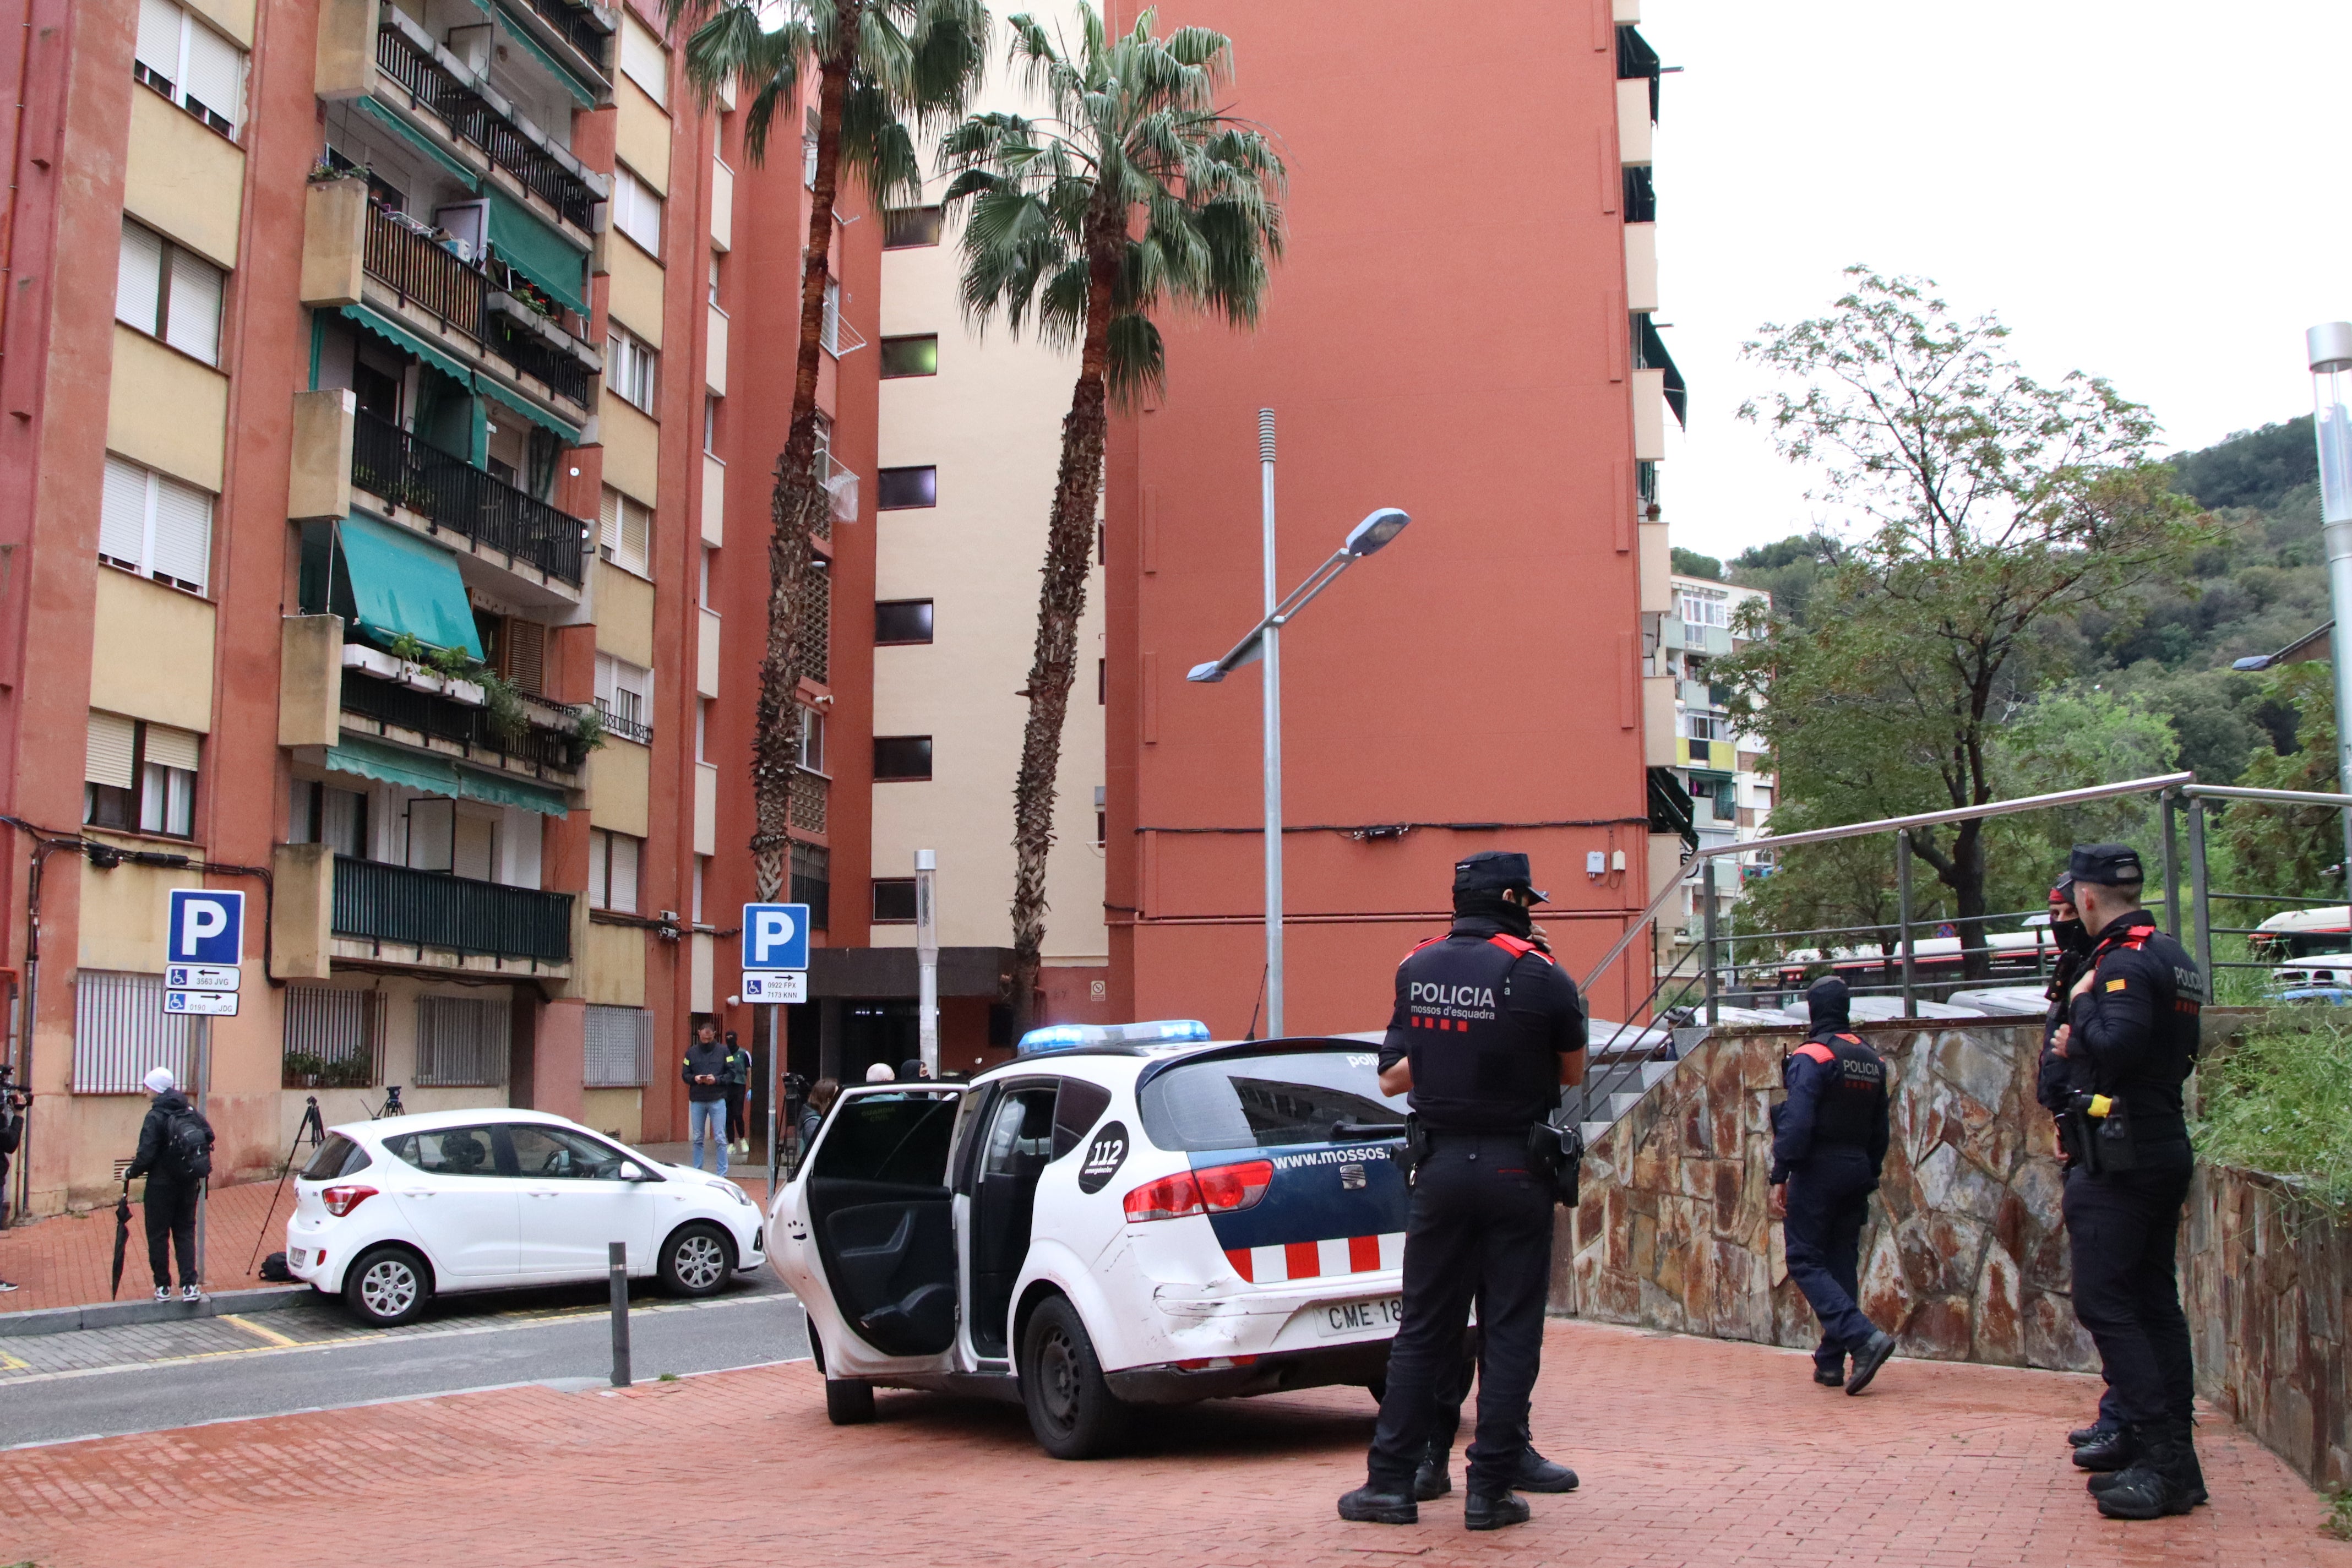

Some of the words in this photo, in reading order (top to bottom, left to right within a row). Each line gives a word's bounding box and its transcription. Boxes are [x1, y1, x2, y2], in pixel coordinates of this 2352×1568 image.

[182, 899, 227, 955] P
[755, 912, 794, 961] P
[1411, 982, 1495, 1008] POLICIA
[1411, 1005, 1441, 1015] mossos
[1444, 1007, 1495, 1020] d'esquadra
[1843, 1059, 1879, 1076] POLICIA
[1089, 1140, 1123, 1166] 112
[1272, 1147, 1391, 1170] www.mossos.
